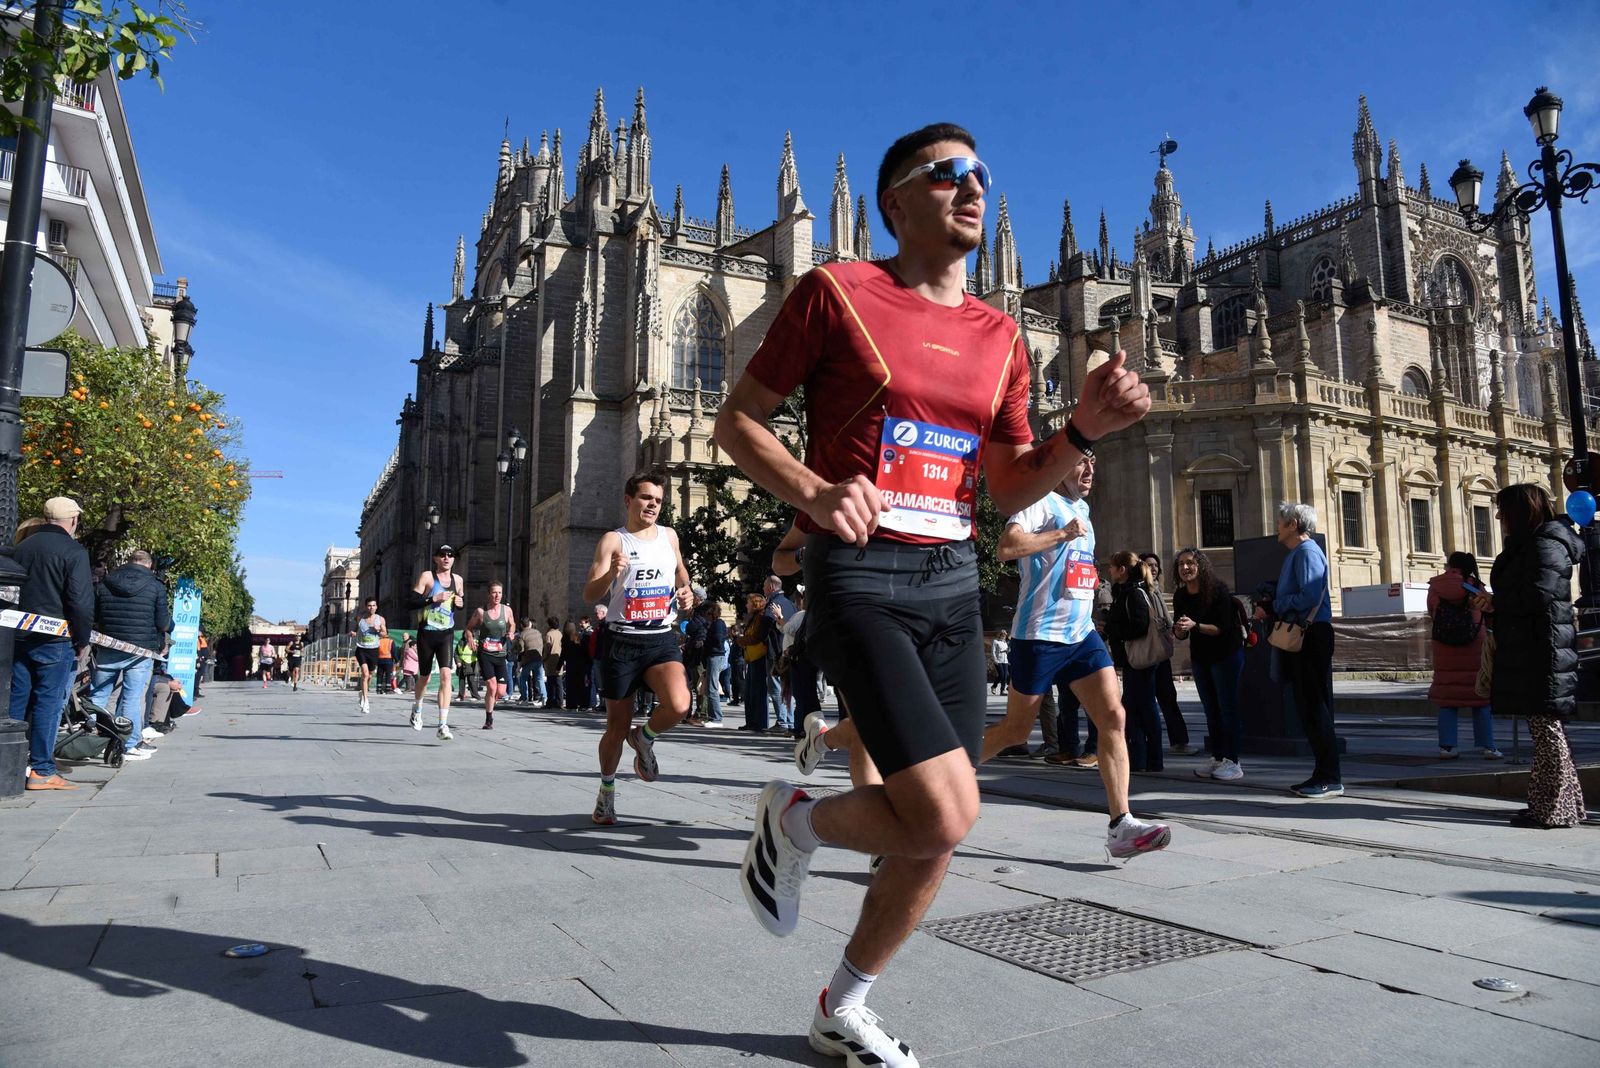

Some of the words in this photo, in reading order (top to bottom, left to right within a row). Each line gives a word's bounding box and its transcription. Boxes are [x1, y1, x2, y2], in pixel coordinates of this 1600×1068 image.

[923, 430, 971, 453] ZURICH
[922, 463, 949, 481] 1314
[641, 588, 666, 596] ZURICH
[175, 613, 188, 624] 50
[190, 616, 198, 624] m
[631, 609, 667, 619] BASTIEN
